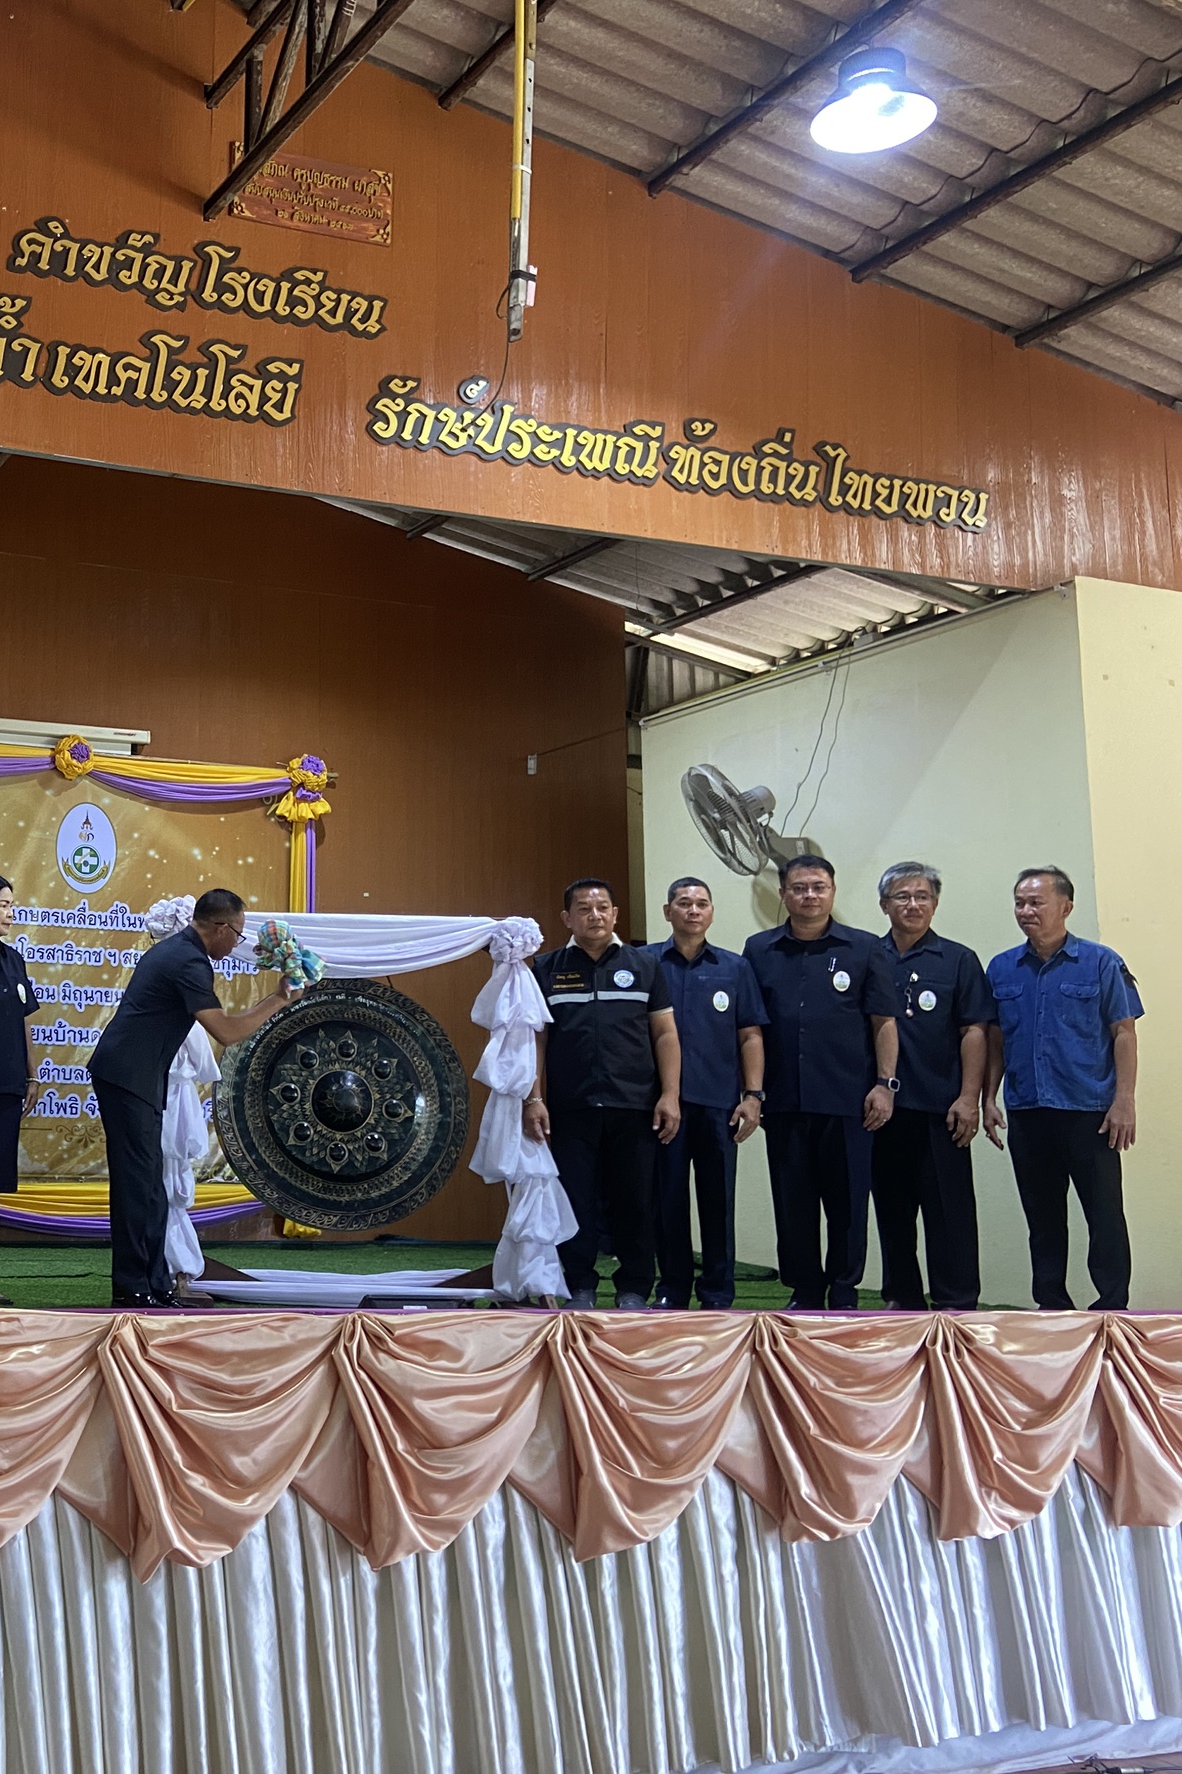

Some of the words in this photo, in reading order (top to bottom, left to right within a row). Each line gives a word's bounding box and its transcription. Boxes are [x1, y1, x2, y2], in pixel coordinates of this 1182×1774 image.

[14, 936, 103, 964] โอรสาธิราช
[33, 1091, 80, 1116] าโพธิ
